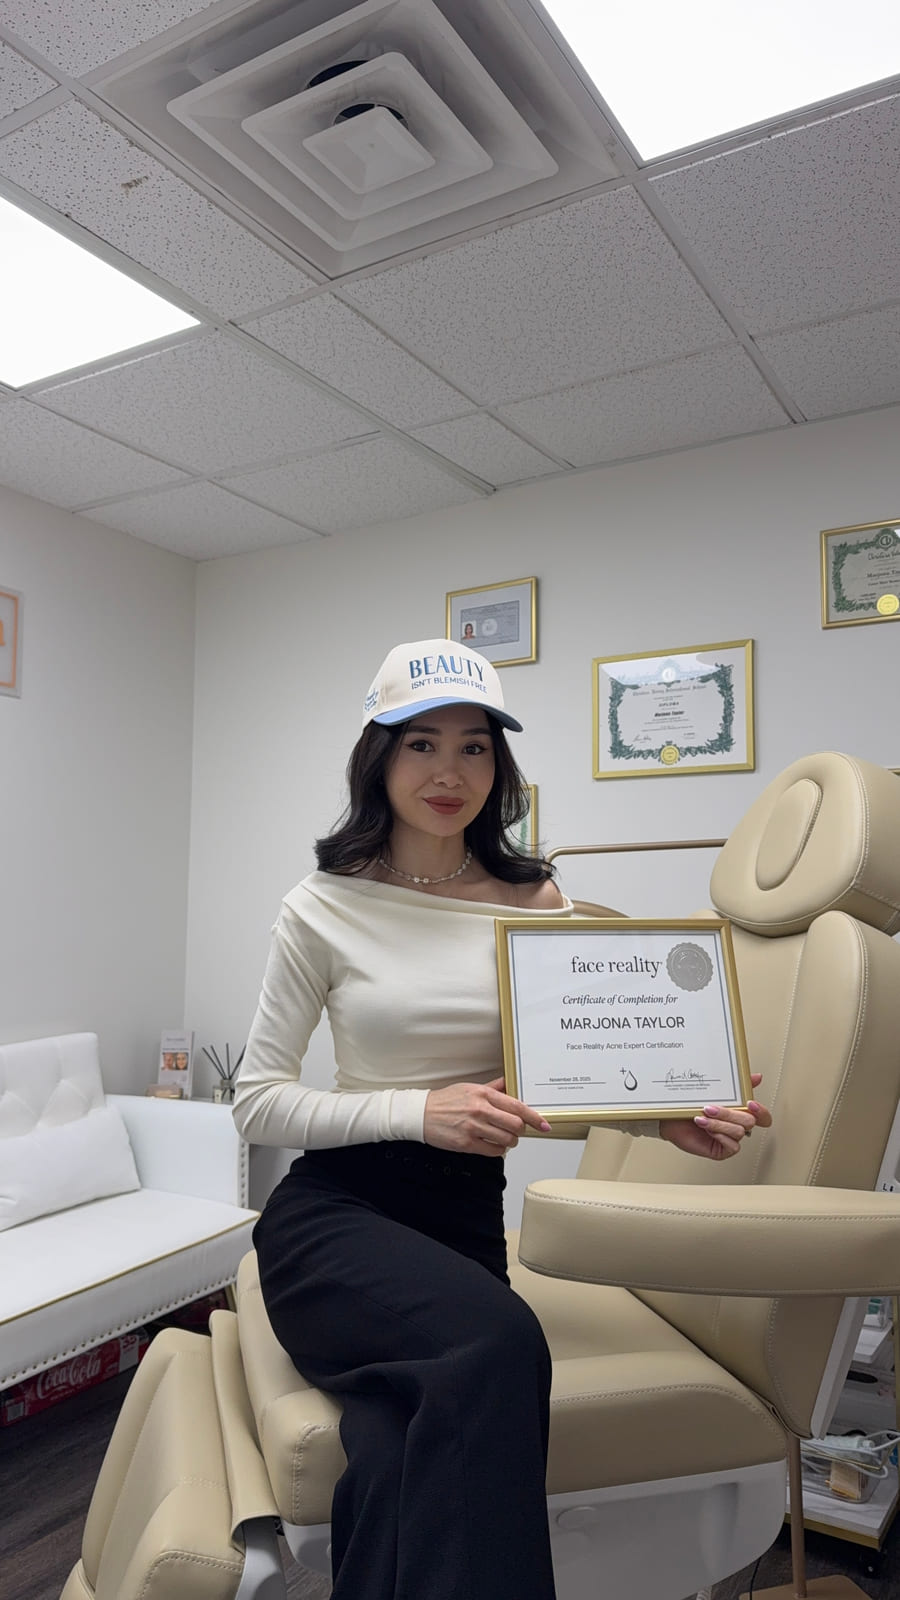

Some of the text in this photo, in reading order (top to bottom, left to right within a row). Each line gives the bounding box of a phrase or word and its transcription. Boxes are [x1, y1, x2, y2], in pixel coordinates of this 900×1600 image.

[409, 654, 484, 681] BEAUTY
[411, 676, 488, 694] ISN'T BLEMISH FREE
[571, 956, 661, 979] face reality
[562, 994, 678, 1007] Certificate of Completion for
[560, 1016, 685, 1030] MARJONA TAYLOR
[566, 1041, 684, 1051] Face Reality Acne Expert Certification
